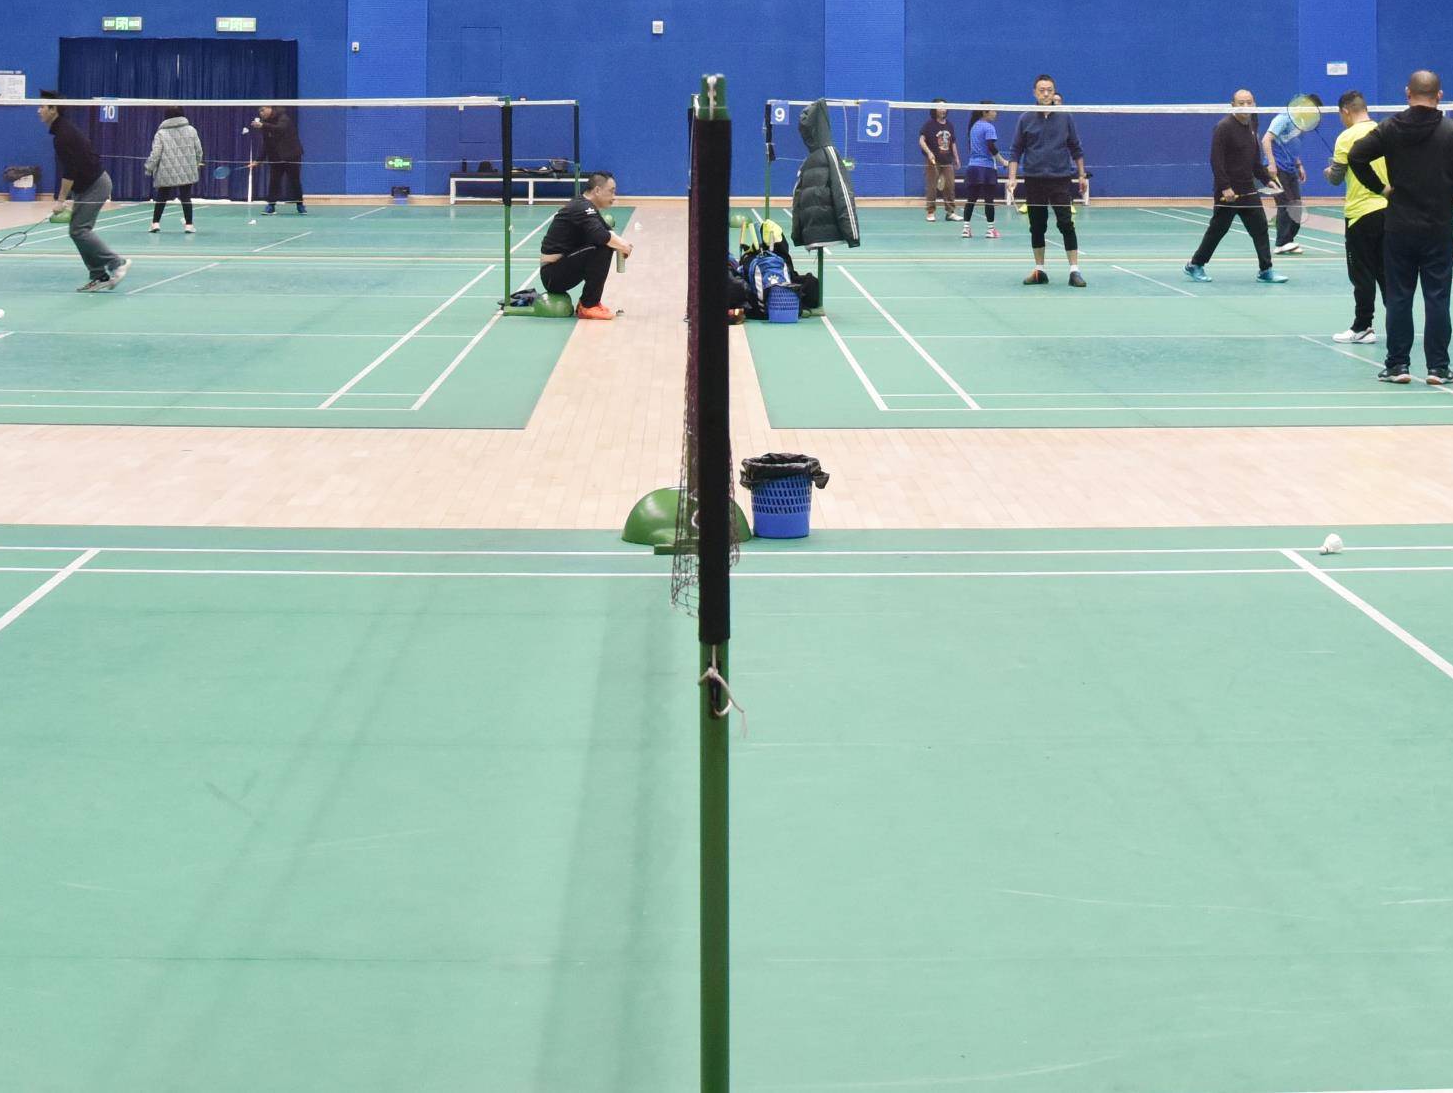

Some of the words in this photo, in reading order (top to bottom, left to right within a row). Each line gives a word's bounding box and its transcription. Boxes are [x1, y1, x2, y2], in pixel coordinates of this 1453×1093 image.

[102, 104, 115, 119] 10
[774, 107, 785, 122] 9
[865, 113, 883, 137] 5
